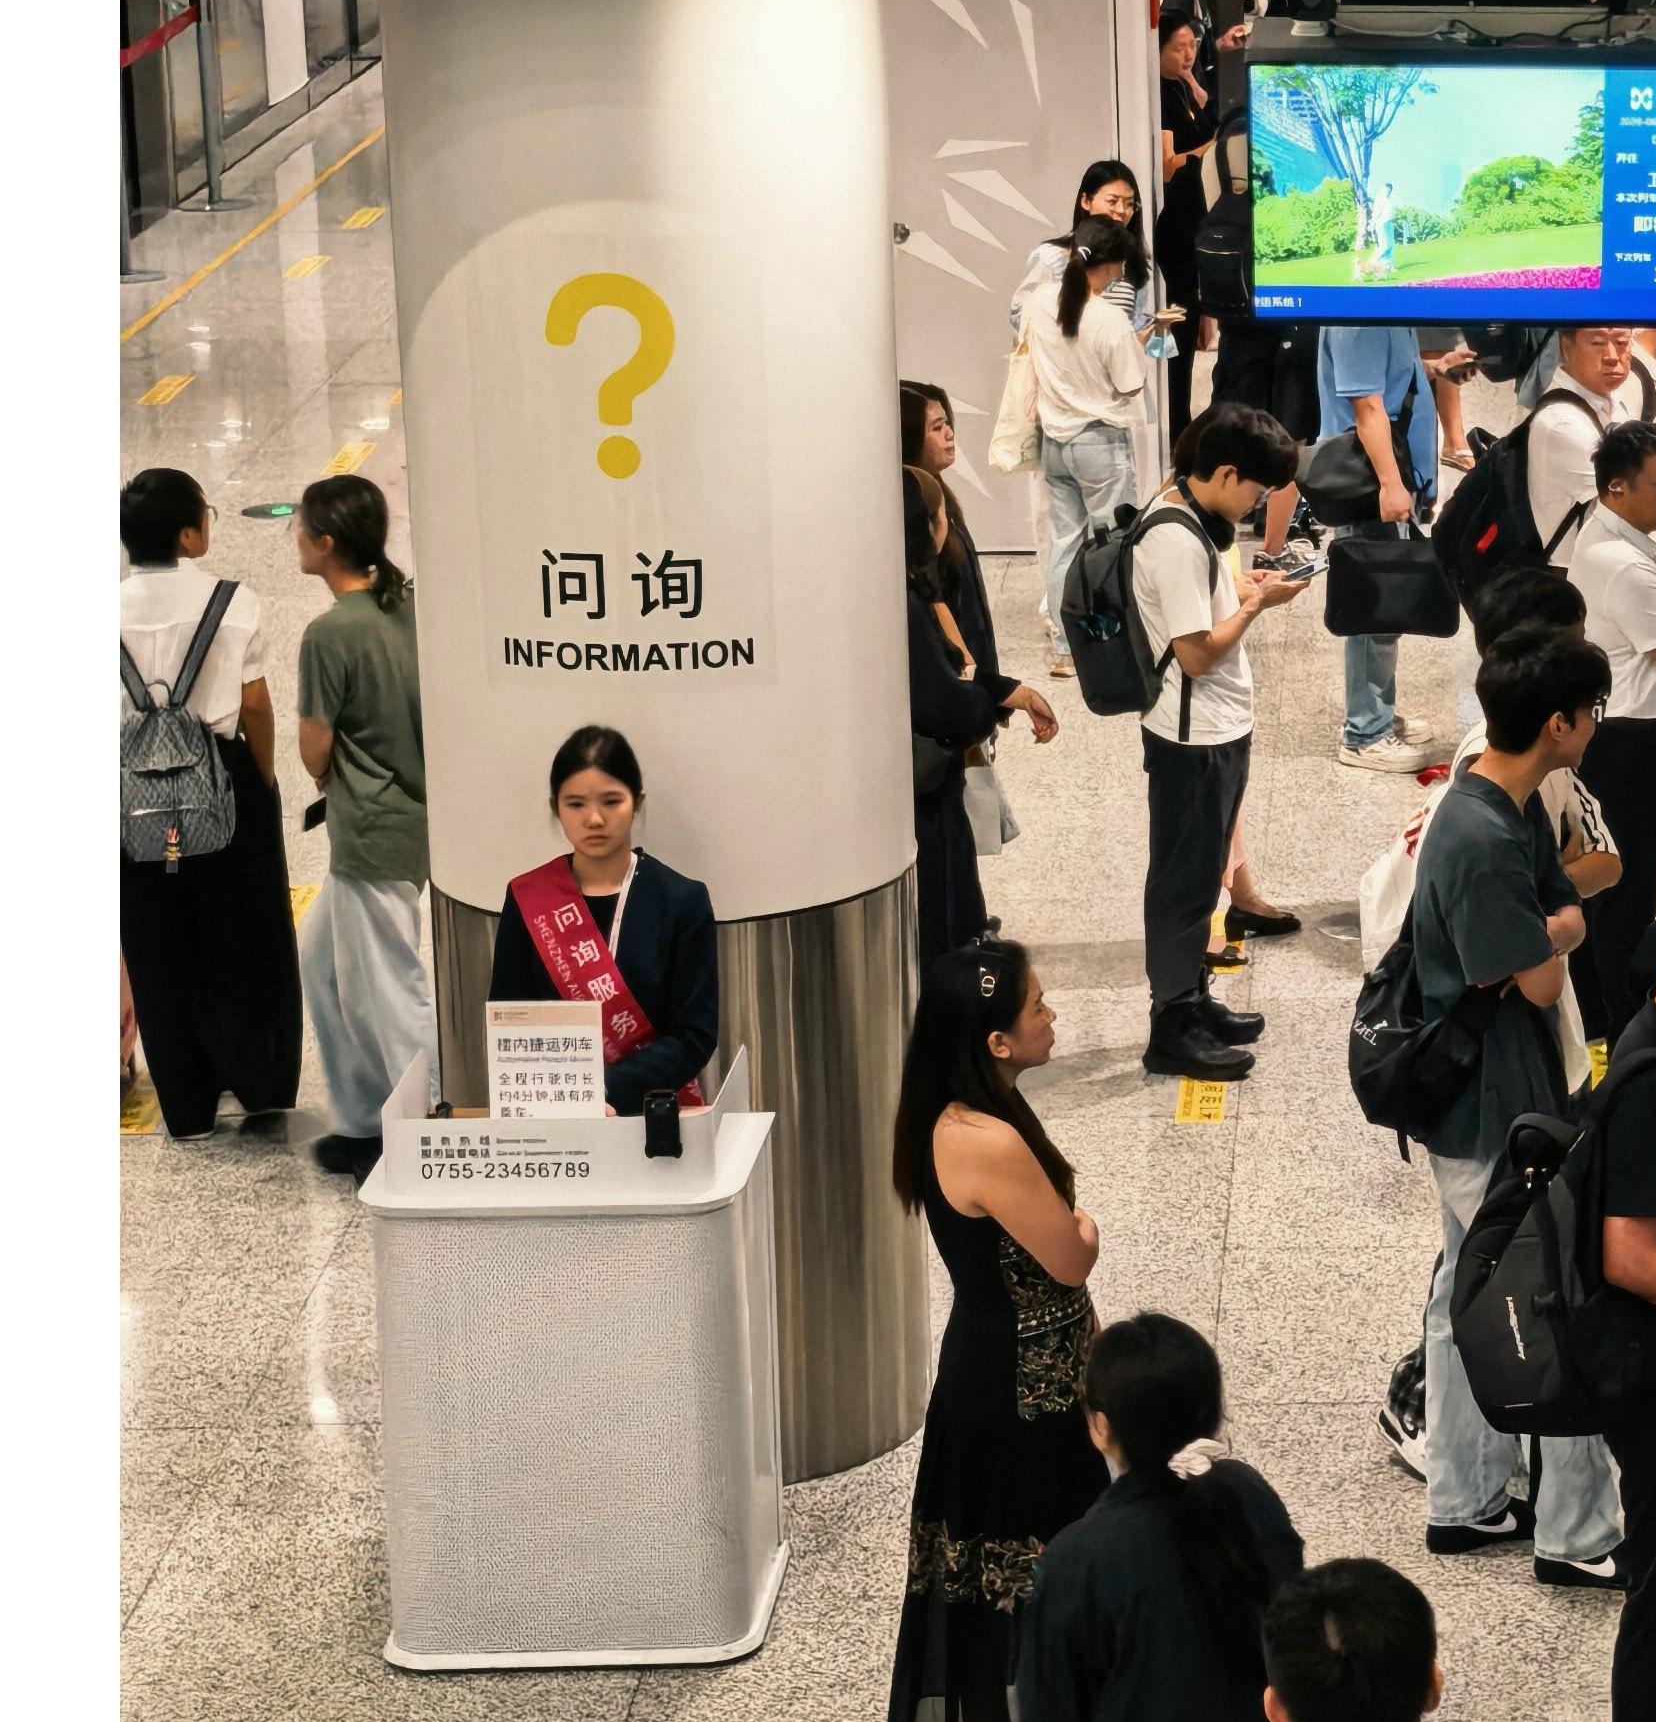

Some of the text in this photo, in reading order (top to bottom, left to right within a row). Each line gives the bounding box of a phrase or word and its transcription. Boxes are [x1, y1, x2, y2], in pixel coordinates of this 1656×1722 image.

[541, 548, 703, 620] 问询
[503, 636, 756, 672] INFORMATION
[551, 902, 639, 1039] 问询服务
[421, 1161, 591, 1180] 0755-23456789
